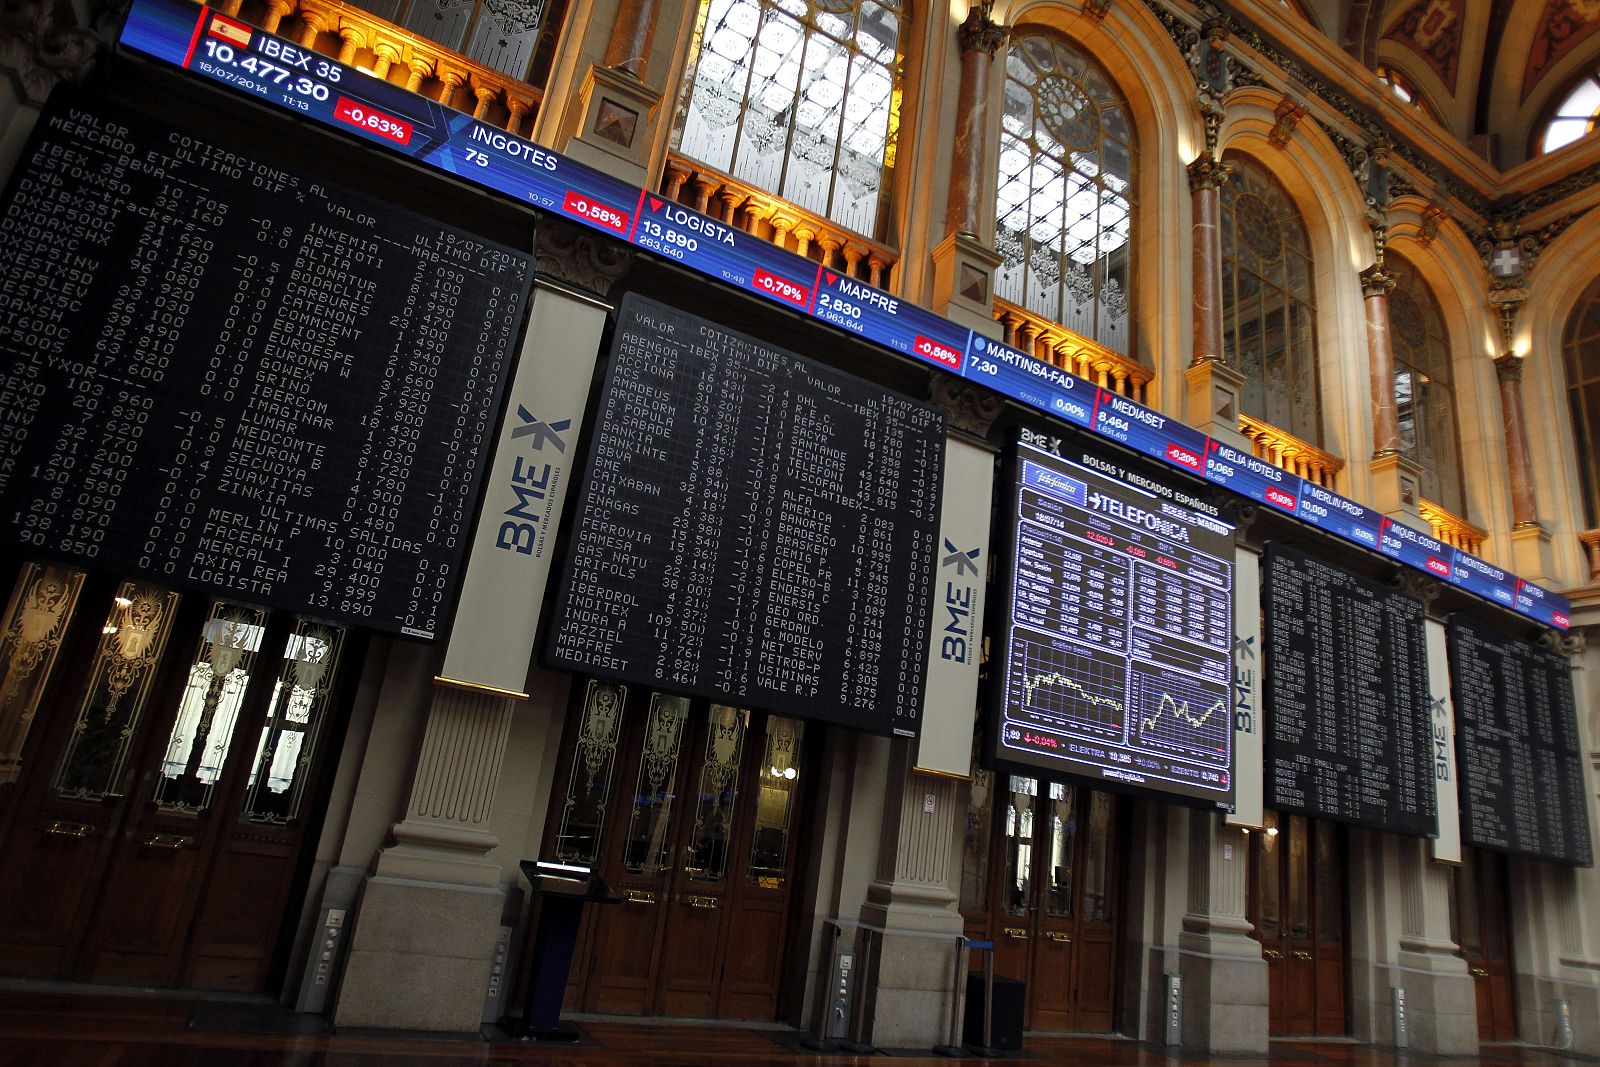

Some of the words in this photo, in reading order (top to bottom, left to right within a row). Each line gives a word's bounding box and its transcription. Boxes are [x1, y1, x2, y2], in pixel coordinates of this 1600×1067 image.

[206, 39, 329, 101] 10.477,30
[258, 36, 311, 71] IBEX
[316, 60, 342, 83] 35
[199, 61, 267, 94] 18/07/2014
[282, 94, 309, 111] 11:13
[343, 108, 404, 139] -0,63%
[49, 115, 135, 154] MERCADO
[146, 150, 181, 168] ETF
[465, 148, 489, 167] 75
[469, 125, 558, 172] INGOTES
[31, 152, 131, 195] ESTOXX50
[155, 195, 223, 226] 32.160
[39, 141, 88, 166] IBEX
[100, 162, 125, 178] 35
[161, 184, 228, 214] 10.705
[250, 218, 292, 237] -0.8
[168, 132, 300, 187] COTIZACIONES
[309, 183, 328, 198] AL
[438, 231, 526, 270] 18/07/2014
[528, 192, 555, 207] 10:57
[13, 191, 115, 232] DXSP500C
[138, 233, 209, 263] 24.190
[19, 178, 121, 219] DXIBX35T
[144, 220, 214, 251] 21.620
[237, 254, 280, 272] -0.5
[570, 199, 622, 228] -0,58%
[665, 205, 735, 247] LOGISTA
[643, 220, 698, 252] 13,890
[303, 233, 383, 268] AB-BIOTI
[413, 271, 461, 295] 2.100
[308, 222, 378, 254] 1NKEMIA
[417, 260, 464, 283] 2.090
[491, 286, 518, 302] 0.0
[639, 235, 684, 260] 263.540
[721, 269, 744, 285] 10:48
[286, 281, 370, 316] CARBURES
[294, 256, 377, 292] BIONATUR
[406, 294, 454, 318] 8.990
[483, 320, 510, 336] 9.5
[758, 275, 802, 301] -0,79%
[839, 279, 899, 315] MAPFRE
[819, 293, 862, 320] 2,830
[268, 330, 354, 366] EUROESPE
[619, 342, 676, 369] ABERTIS
[259, 357, 314, 381] GOWEX
[622, 331, 678, 358] ABENGOA
[761, 383, 789, 398] -2.4
[970, 355, 998, 376] 7,30
[987, 343, 1074, 390] MARTINSA-FAD
[66, 377, 154, 409] 103.960
[612, 375, 669, 402] AMADEUS
[247, 396, 333, 430] IMAGINAR
[797, 393, 817, 408] OHL
[864, 418, 903, 438] 31.135
[916, 439, 940, 451] -1.5
[882, 394, 942, 423] 18/07/2014
[1056, 398, 1085, 418] 0,00%
[1099, 411, 1129, 432] 8,464
[1112, 397, 1165, 430] MEDIASET
[602, 420, 652, 444] BANKIA
[793, 414, 834, 436] REPSOL
[863, 438, 901, 458] 18.510
[226, 451, 306, 481] SECUOYA
[791, 435, 846, 461] SANTANDE
[867, 460, 899, 478] 7.298
[1169, 448, 1198, 466] -0,20%
[1207, 459, 1234, 478] 9,065
[1220, 447, 1246, 467] MELIA
[1249, 458, 1282, 482] HOTELS
[592, 468, 660, 496] CAIXABAN
[789, 456, 843, 482] TELEFONI
[858, 479, 897, 499] 12.020
[910, 498, 935, 511] -0.7
[1082, 453, 1116, 476] BOLSAS
[1117, 467, 1125, 480] Y
[1128, 472, 1172, 498] MERCADOS
[1175, 490, 1218, 515] ESPAÑOLES
[536, 536, 545, 558] BOLSAS
[542, 500, 553, 531] MERCADOS
[550, 467, 561, 498] ESPAÑOLES
[1268, 491, 1293, 507] -0,93%
[1301, 500, 1327, 517] 10,000
[1311, 487, 1340, 510] MERLIN
[1342, 499, 1364, 519] PROP.
[207, 507, 278, 534] MERLIN
[289, 527, 300, 538] P
[324, 536, 387, 560] 10.000
[260, 504, 338, 533] ULTIMAS
[348, 526, 422, 554] SALIDAS
[582, 516, 651, 544] FERROVIA
[780, 510, 830, 534] BANORTE
[858, 534, 891, 552] 5.010
[1102, 496, 1188, 542] TELEFONICA
[1355, 528, 1374, 542] 0,00%
[1382, 535, 1401, 549] 31,39
[1391, 523, 1417, 543] MIQUEL
[1419, 536, 1441, 553] COSTA
[1428, 561, 1448, 574] -0,79%
[1454, 567, 1469, 579] 1,110
[1462, 555, 1504, 581] MONTEBALITO
[187, 566, 271, 595] LOGISTA
[307, 592, 372, 616] 13.890
[394, 613, 435, 630] -0.8
[569, 580, 638, 606] IBERDROL
[1525, 585, 1544, 599] NATRA
[554, 646, 628, 670] MEDIASET
[758, 663, 819, 685] USIMINAS
[759, 651, 820, 673] PETROB-P
[842, 670, 877, 686] 6.305
[1069, 742, 1105, 759] ELEKTRA
[1274, 731, 1299, 743] ZELTIA
